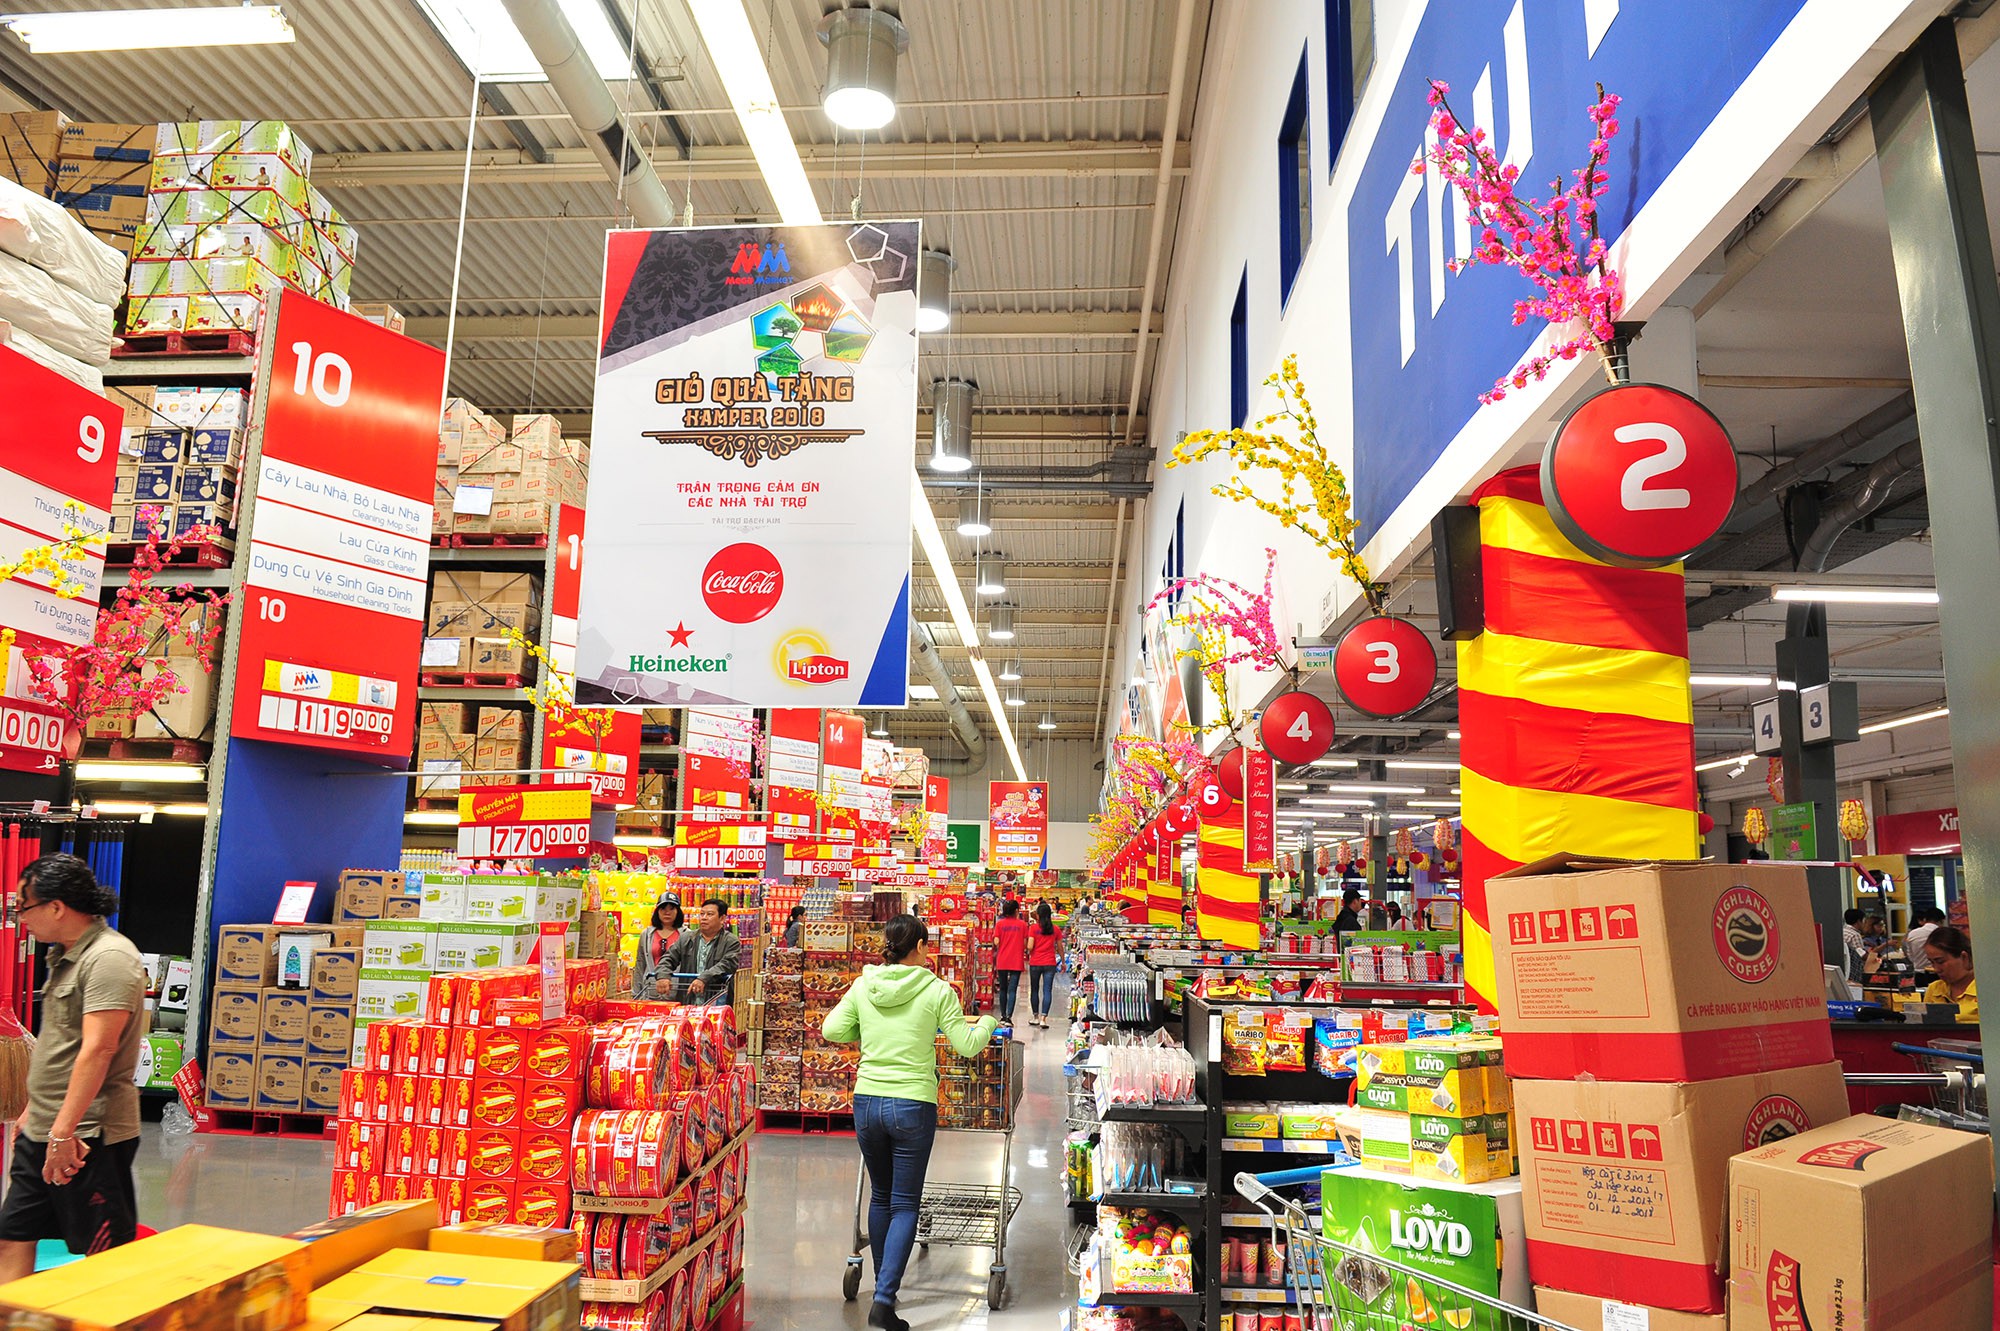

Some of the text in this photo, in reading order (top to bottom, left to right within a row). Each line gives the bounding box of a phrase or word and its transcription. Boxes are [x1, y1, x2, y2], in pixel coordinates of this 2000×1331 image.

[292, 340, 353, 407] 10
[656, 371, 855, 407] GIỎ QUÀ TẶNG
[682, 404, 826, 429] HAMPER 2018
[77, 414, 105, 463] 9
[1614, 422, 1690, 511] 2
[265, 468, 291, 487] Cây
[296, 476, 319, 493] Lau
[353, 493, 370, 508] Bộ
[373, 499, 395, 515] Lau
[398, 507, 420, 523] Nhà
[677, 480, 820, 495] TRÂN TRỌNG CẢM ƠN
[34, 496, 61, 520] Thùng
[688, 495, 808, 510] CÁC NHÀ TÀI TRỢ
[352, 509, 419, 534] Cleaning Mop Set
[339, 532, 417, 562] Lau Cửa Kính
[61, 559, 77, 574] Rác
[80, 565, 97, 580] Inox
[363, 554, 416, 574] Glass Cleaner
[254, 556, 413, 602] Dụng Cụ Vệ Sinh Gia Đình
[705, 570, 780, 595] Coca-Cola
[258, 595, 287, 623] 10
[313, 586, 411, 614] Household Cleaning Tools
[34, 601, 91, 627] Túi Đựng Rác
[56, 622, 90, 641] Gabage Bag
[793, 661, 845, 678] Lipton
[1366, 641, 1400, 683] 3
[1809, 701, 1823, 729] 3
[829, 724, 843, 743] 14
[1287, 711, 1312, 741] 4
[1761, 713, 1774, 739] 4
[691, 757, 701, 771] 12
[772, 788, 780, 799] 13
[928, 784, 937, 797] 16
[1203, 785, 1219, 805] 6
[483, 803, 517, 821] PROMOTION
[1716, 892, 1774, 930] HIGHLANDS
[1582, 922, 1592, 933] kg
[1727, 953, 1774, 976] COFFEE
[1687, 1003, 1698, 1018] CÀ
[1700, 1000, 1715, 1016] PHÊ
[1716, 1003, 1736, 1015] RANG
[1738, 1001, 1750, 1014] XAY
[1769, 1000, 1789, 1013] HẠNG
[1790, 996, 1804, 1011] VIỆT
[1805, 997, 1821, 1008] NAM
[1234, 1030, 1264, 1039] HARIBO
[1273, 1024, 1302, 1035] HARIBO
[1328, 1030, 1359, 1040] HARIBO
[1379, 1033, 1405, 1042] HARIBO
[1415, 1056, 1444, 1071] LOYD
[1407, 1076, 1431, 1086] CLASSIC
[1368, 1089, 1395, 1105] LOYD
[1421, 1119, 1449, 1136] LOYD
[1413, 1139, 1436, 1151] CLASSIC
[1603, 1139, 1614, 1151] kg
[1806, 1141, 1877, 1165] TikTok
[1390, 1209, 1472, 1257] LOYD
[1406, 1250, 1456, 1267] The Magic Experience
[1835, 1278, 1845, 1290] kg
